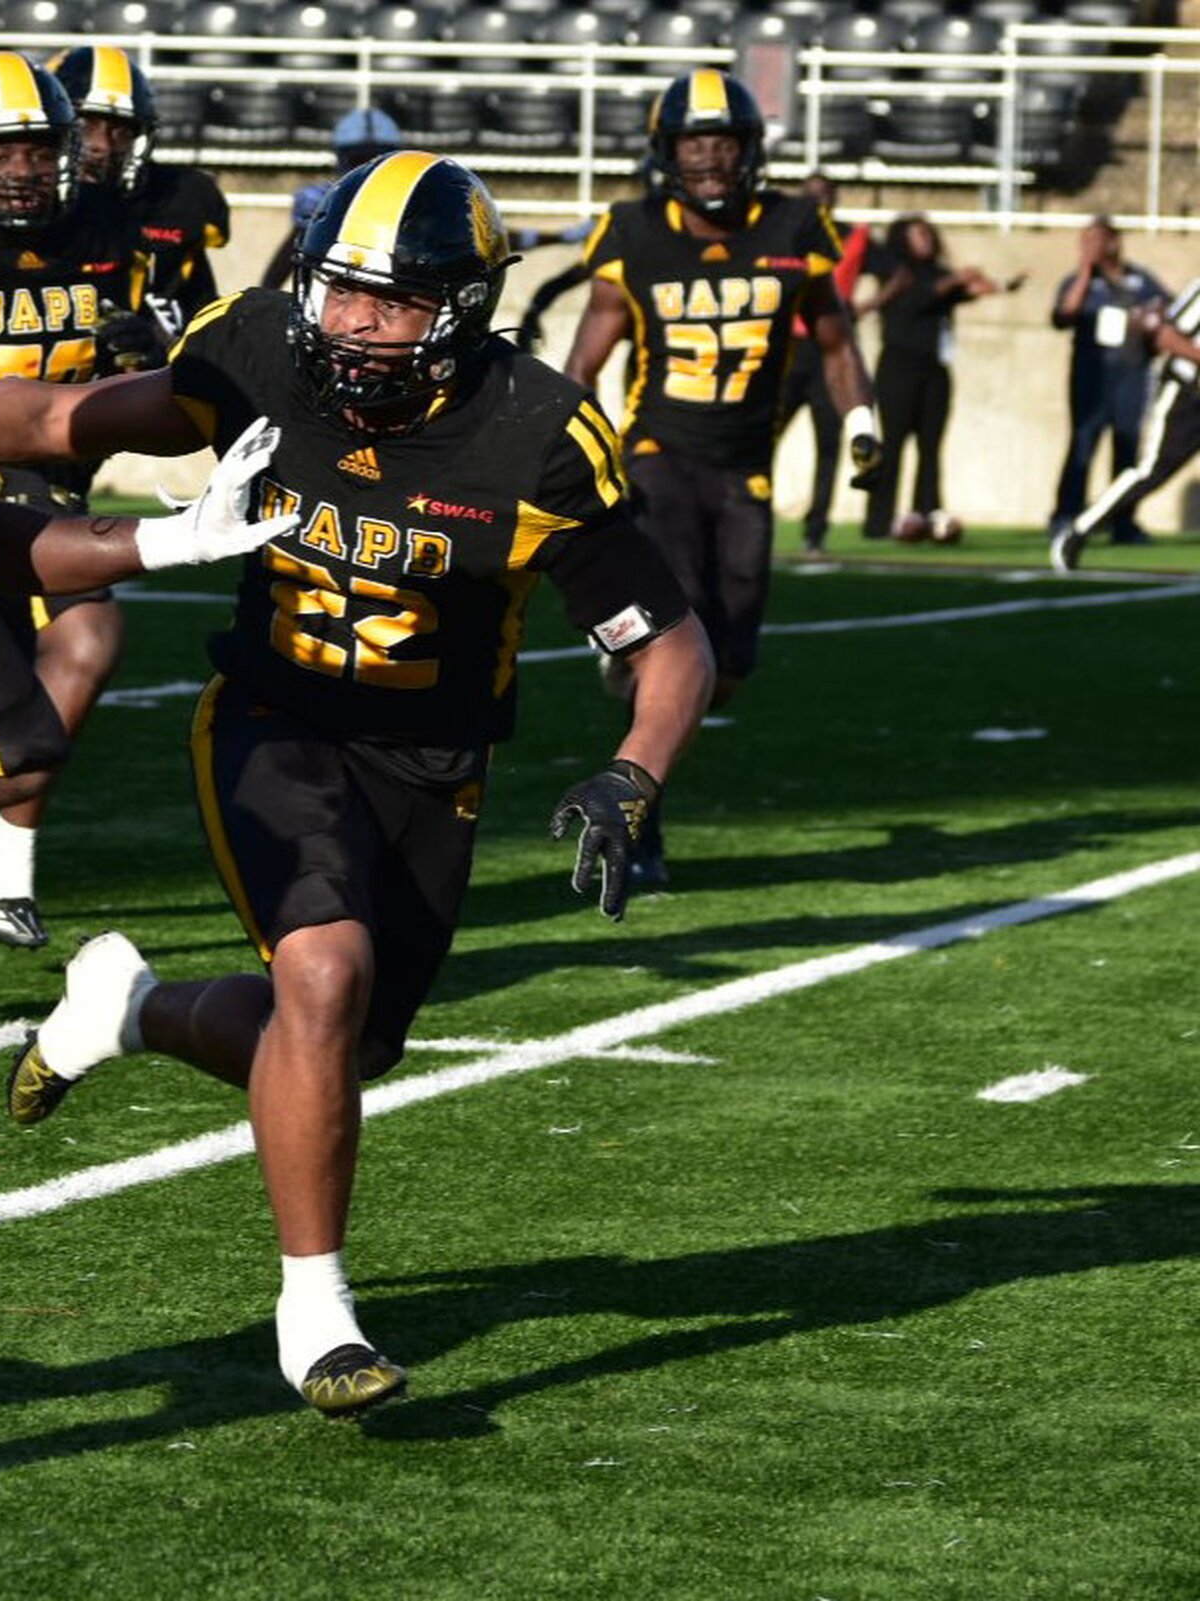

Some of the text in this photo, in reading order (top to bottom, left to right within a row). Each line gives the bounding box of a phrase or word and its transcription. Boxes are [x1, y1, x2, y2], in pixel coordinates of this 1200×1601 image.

[664, 318, 772, 403] 27
[258, 476, 452, 579] UAPB
[428, 501, 494, 523] SWAC
[265, 543, 441, 690] 22
